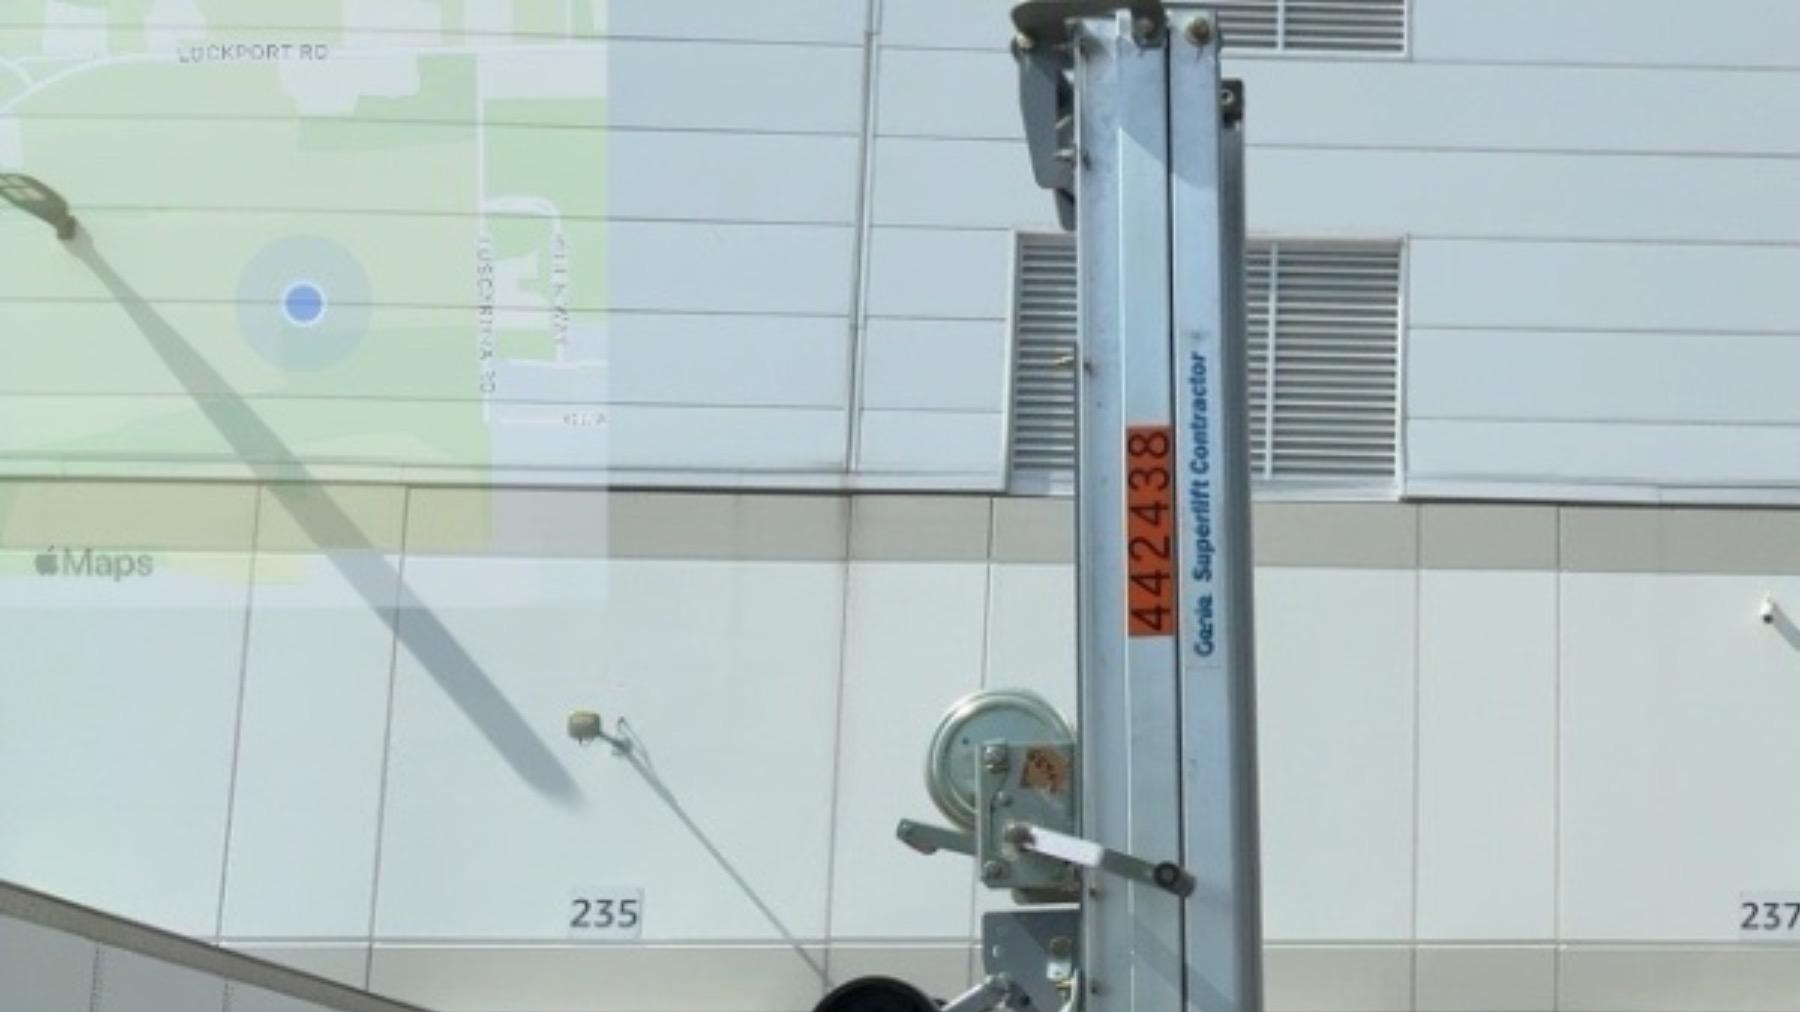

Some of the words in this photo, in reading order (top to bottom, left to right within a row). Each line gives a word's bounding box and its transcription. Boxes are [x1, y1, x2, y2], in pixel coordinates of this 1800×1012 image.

[1188, 352, 1209, 475] Contractor
[1127, 430, 1171, 632] 442438
[1190, 479, 1215, 582] Superlift
[570, 899, 638, 928] 235
